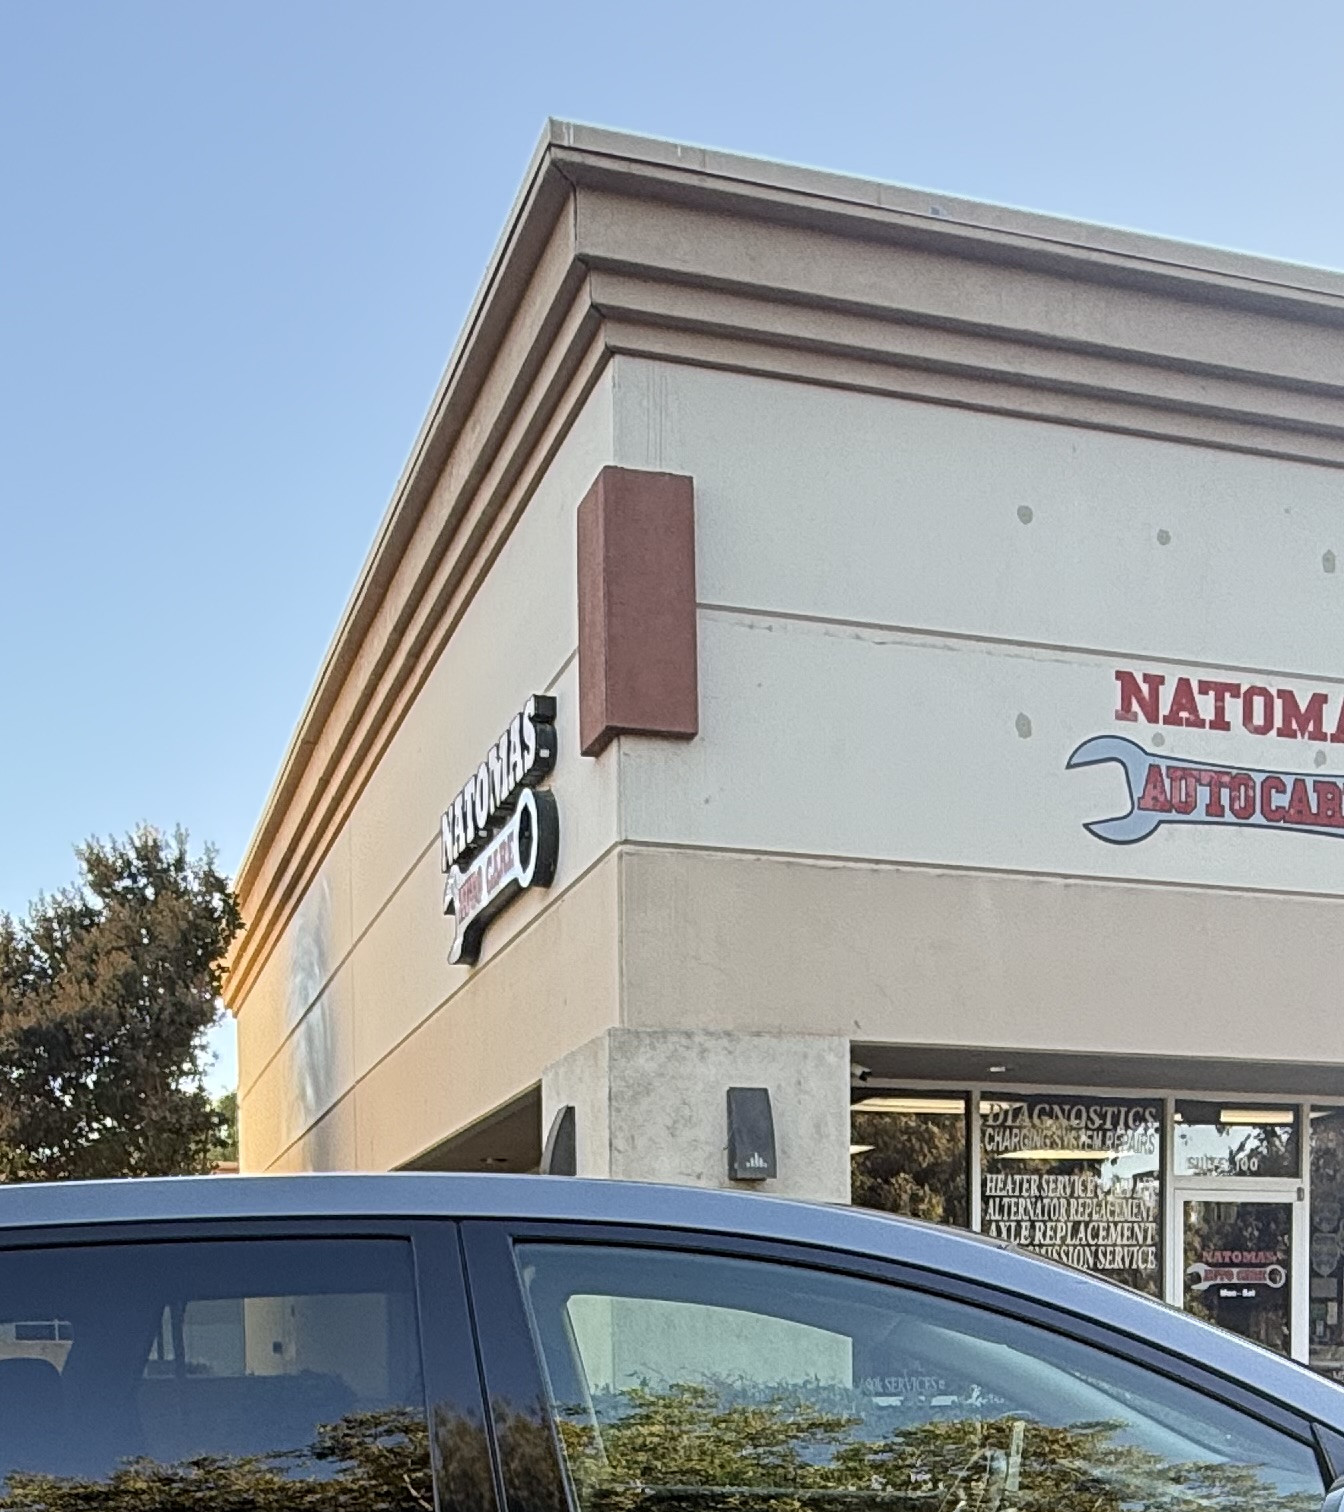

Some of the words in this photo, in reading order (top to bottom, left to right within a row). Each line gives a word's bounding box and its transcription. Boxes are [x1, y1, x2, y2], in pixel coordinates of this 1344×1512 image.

[441, 694, 537, 874] NATOMAS
[1137, 763, 1256, 820] AUTO
[986, 1102, 1157, 1129] DIAGNOSTICS
[985, 1128, 1051, 1151] CHARGING
[986, 1174, 1040, 1196] HEATER
[1041, 1175, 1096, 1197] SERVICE
[986, 1198, 1068, 1221] ALTERNATOR
[1069, 1199, 1155, 1221] REPLACEMENT
[989, 1221, 1031, 1245] AXLE
[1034, 1221, 1156, 1245] REPLACEMENT
[1097, 1246, 1156, 1269] SERVICE
